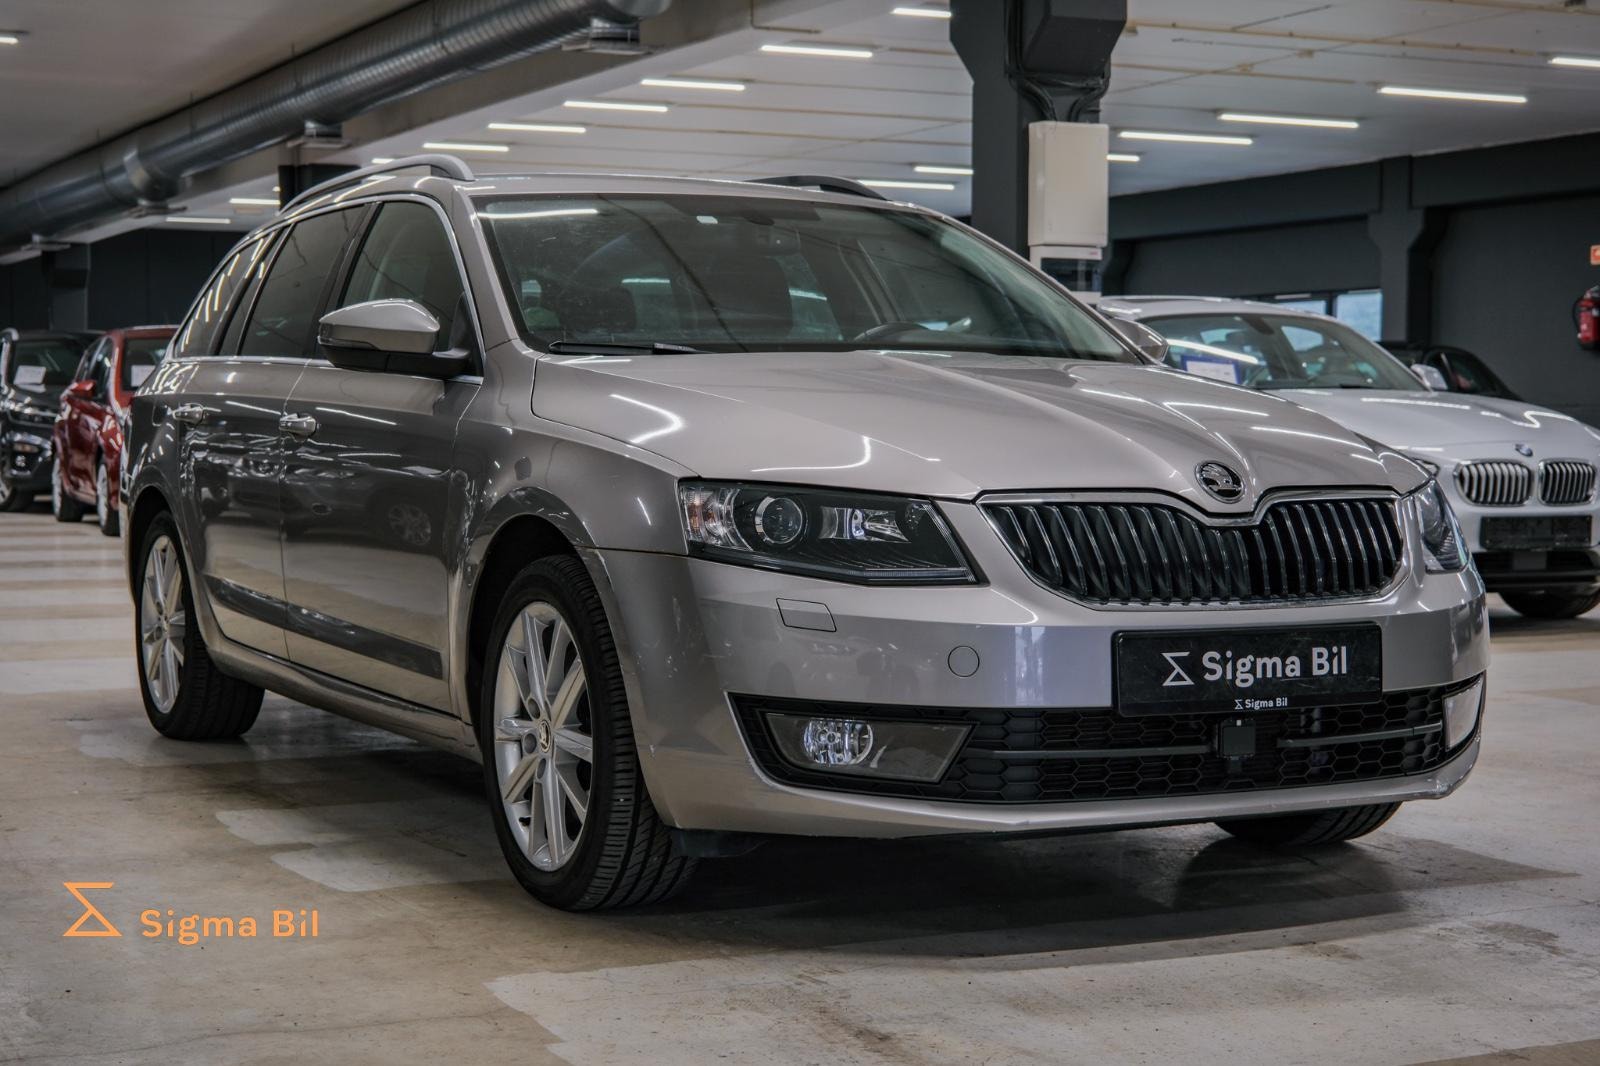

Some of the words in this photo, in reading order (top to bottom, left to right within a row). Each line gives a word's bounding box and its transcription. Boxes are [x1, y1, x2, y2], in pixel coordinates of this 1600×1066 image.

[1202, 651, 1301, 688] Sigma
[1312, 646, 1347, 676] Bil
[1245, 699, 1274, 710] Sigma
[1276, 697, 1288, 707] Bil
